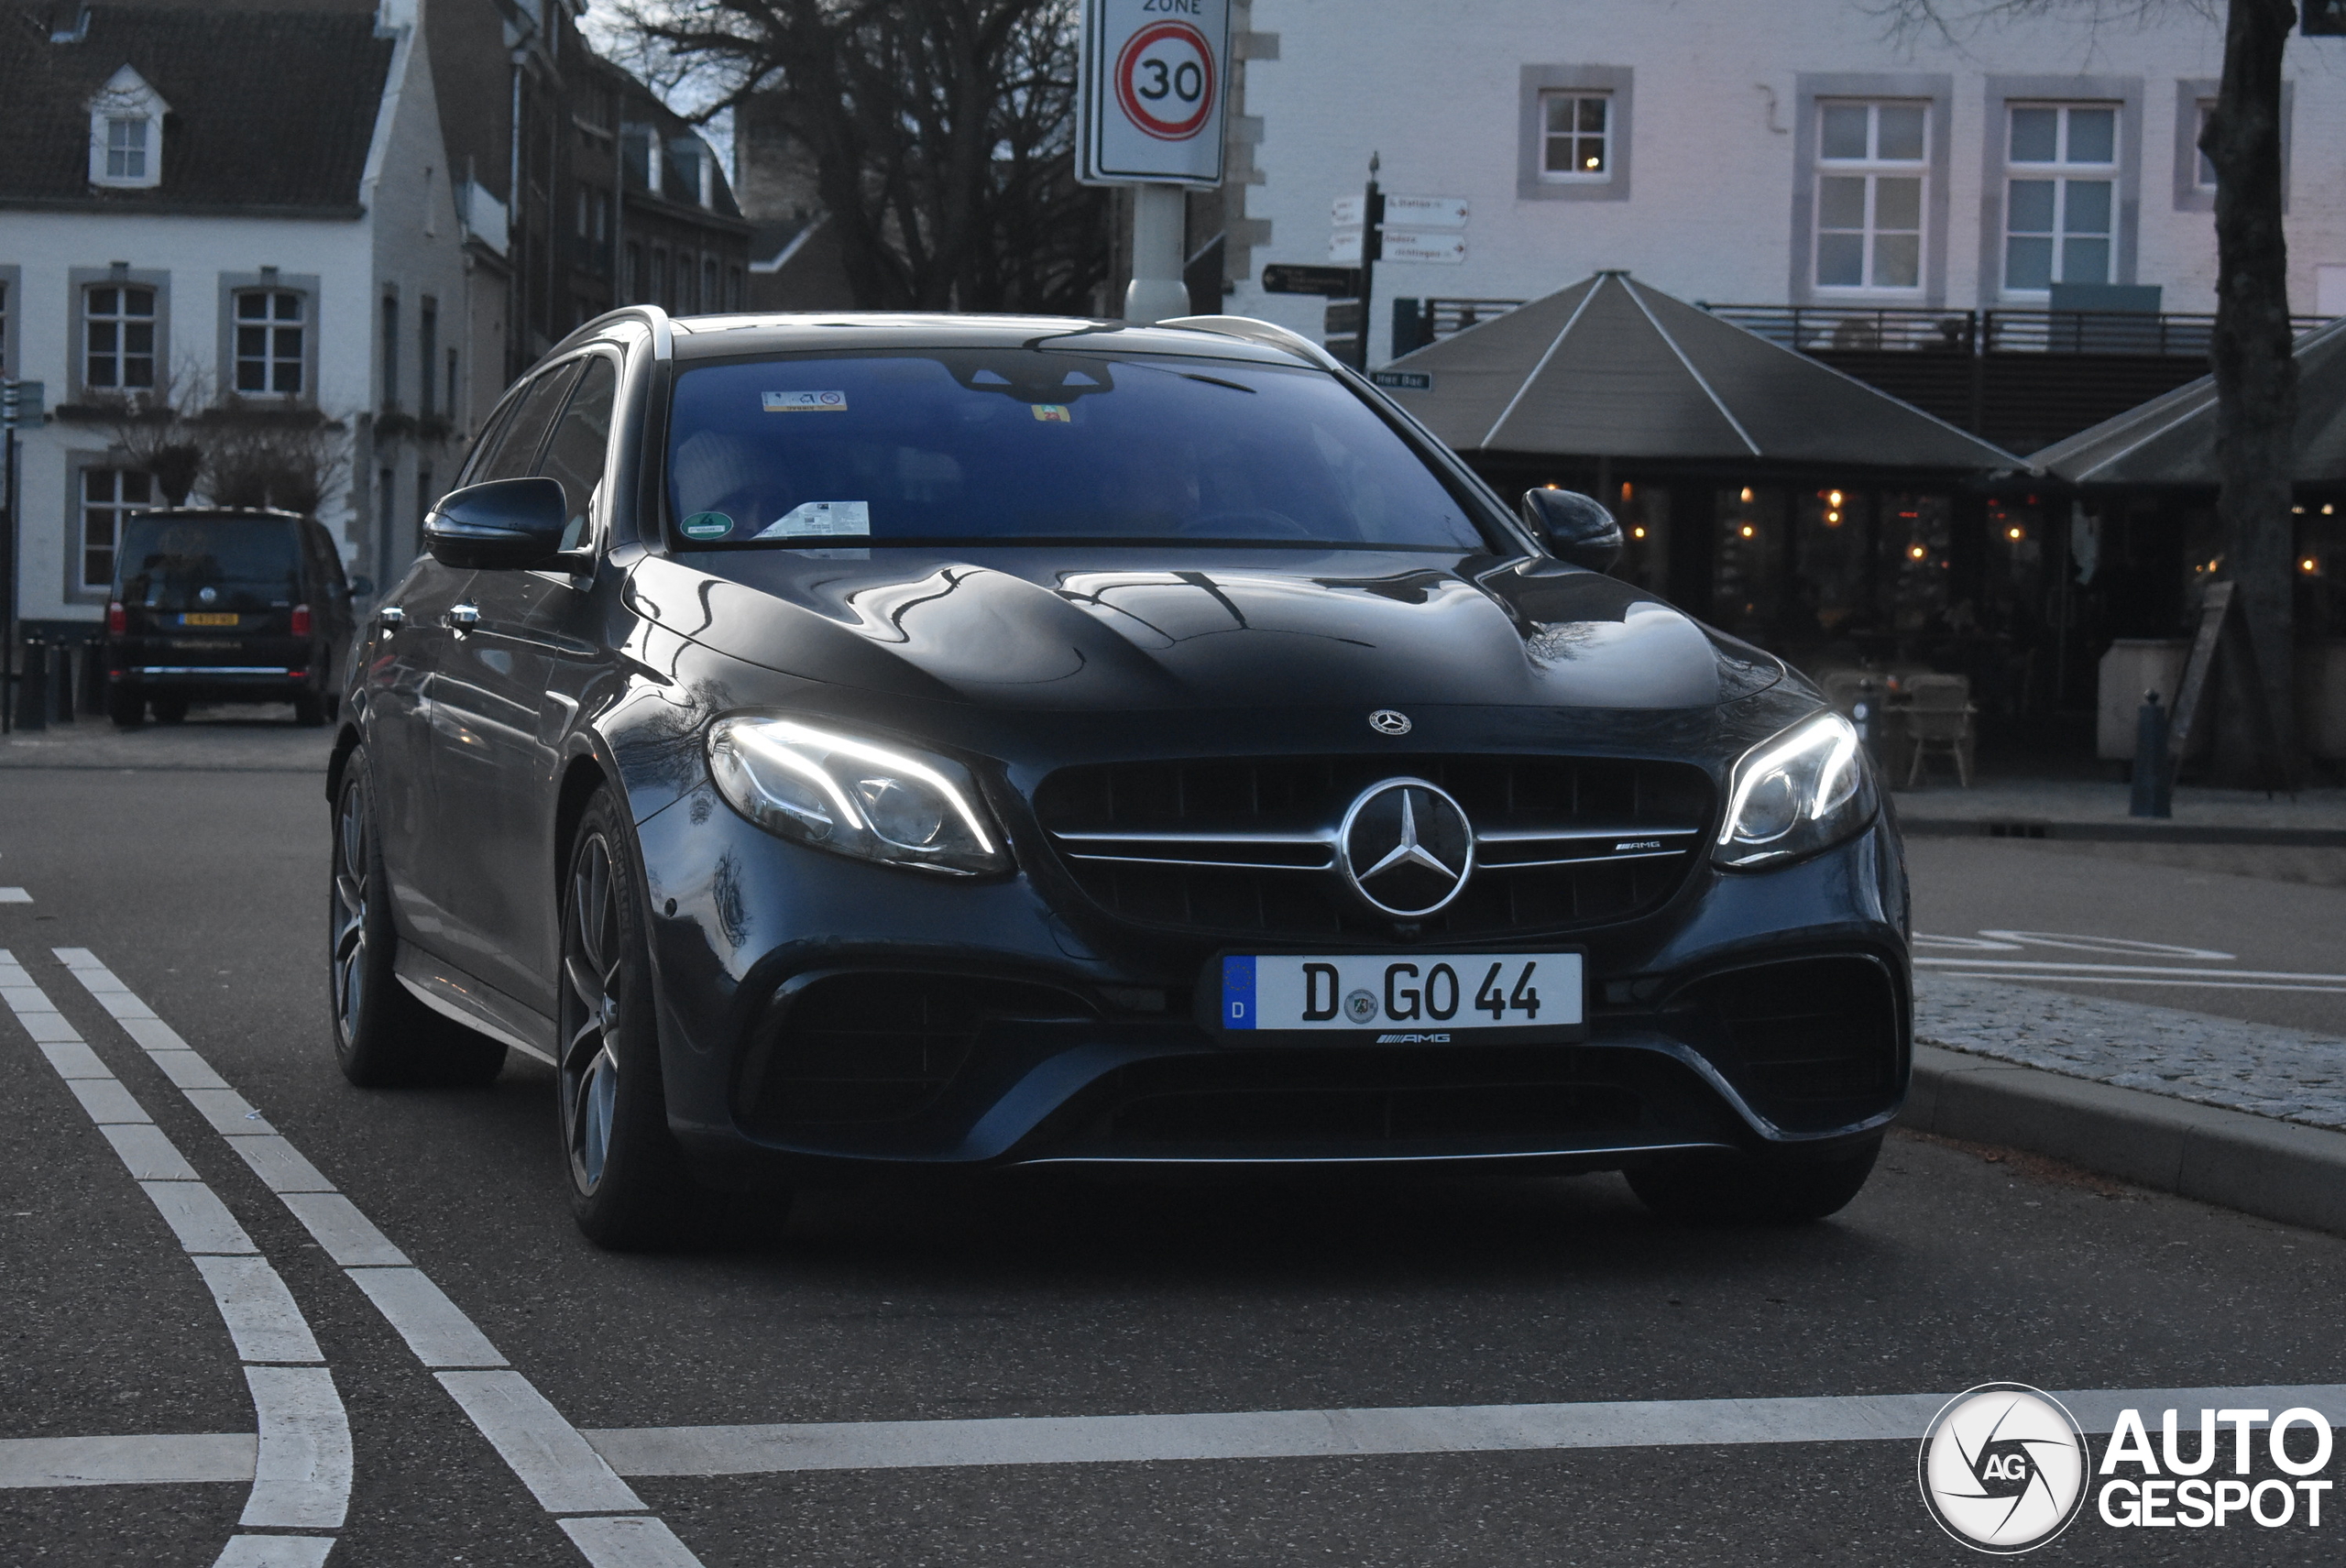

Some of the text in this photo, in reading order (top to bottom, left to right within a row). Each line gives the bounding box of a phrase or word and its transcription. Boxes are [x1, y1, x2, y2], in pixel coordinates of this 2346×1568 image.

[1143, 0, 1200, 14] ZONE
[1138, 59, 1201, 102] 30
[1630, 840, 1660, 849] AMG
[1301, 962, 1339, 1021] D
[1385, 962, 1459, 1021] GO
[1474, 961, 1540, 1020] 44
[1233, 1002, 1244, 1017] D
[1400, 1034, 1451, 1043] AMG
